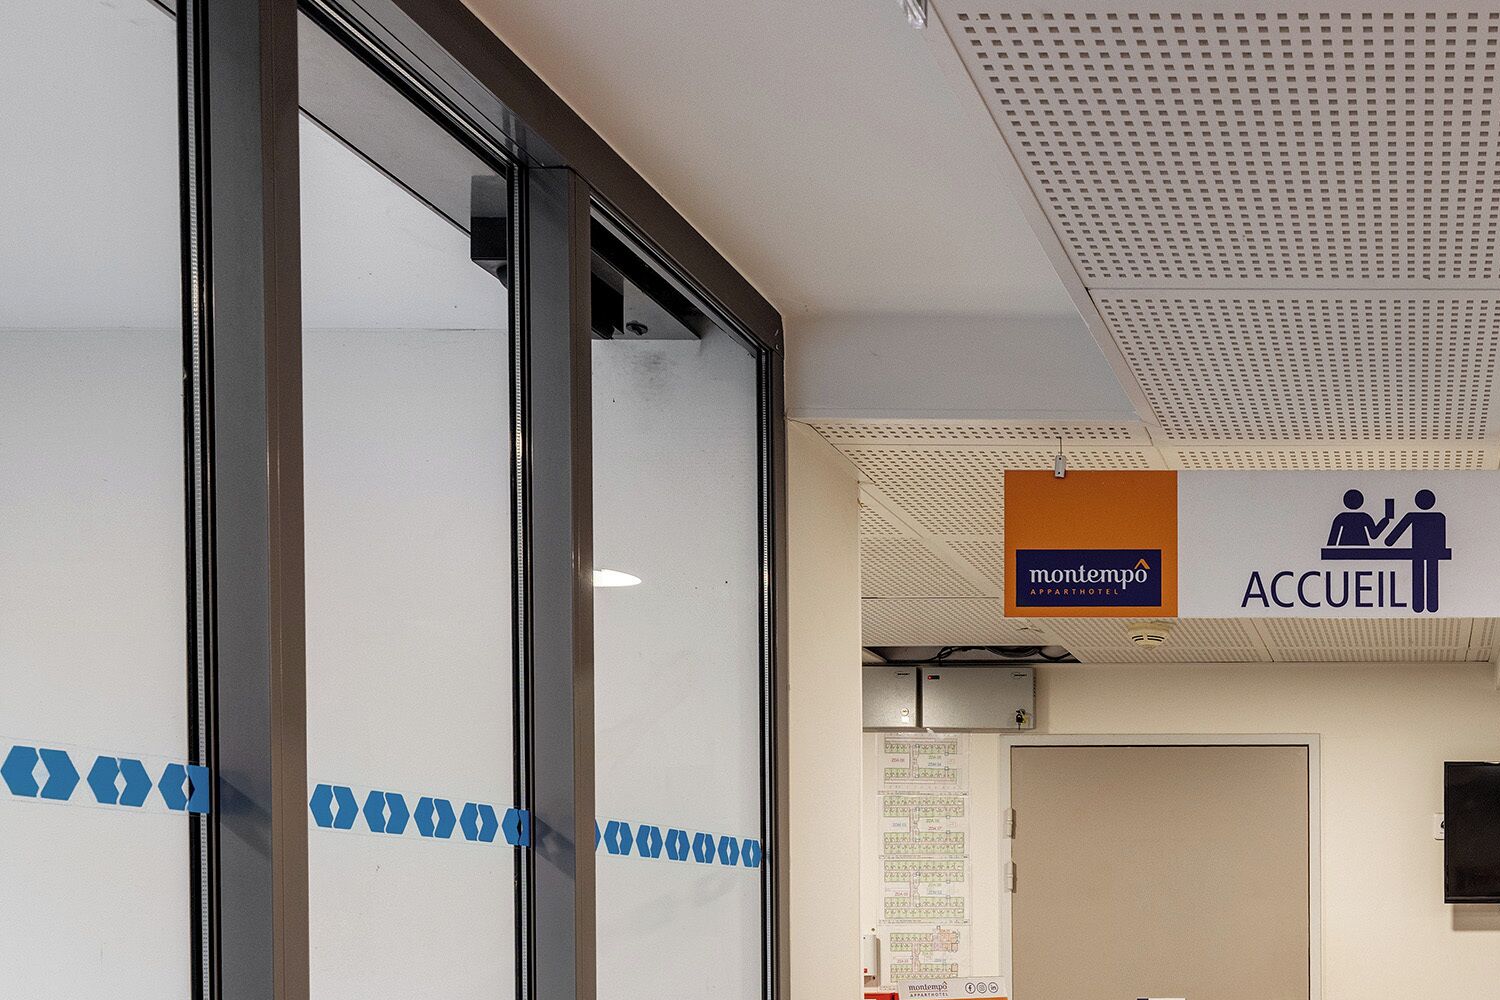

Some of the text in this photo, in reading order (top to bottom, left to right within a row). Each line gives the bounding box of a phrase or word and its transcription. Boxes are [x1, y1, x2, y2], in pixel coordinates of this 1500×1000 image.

[1029, 558, 1150, 590] montempô
[1241, 571, 1408, 608] ACCUEIL
[908, 981, 948, 992] montempô
